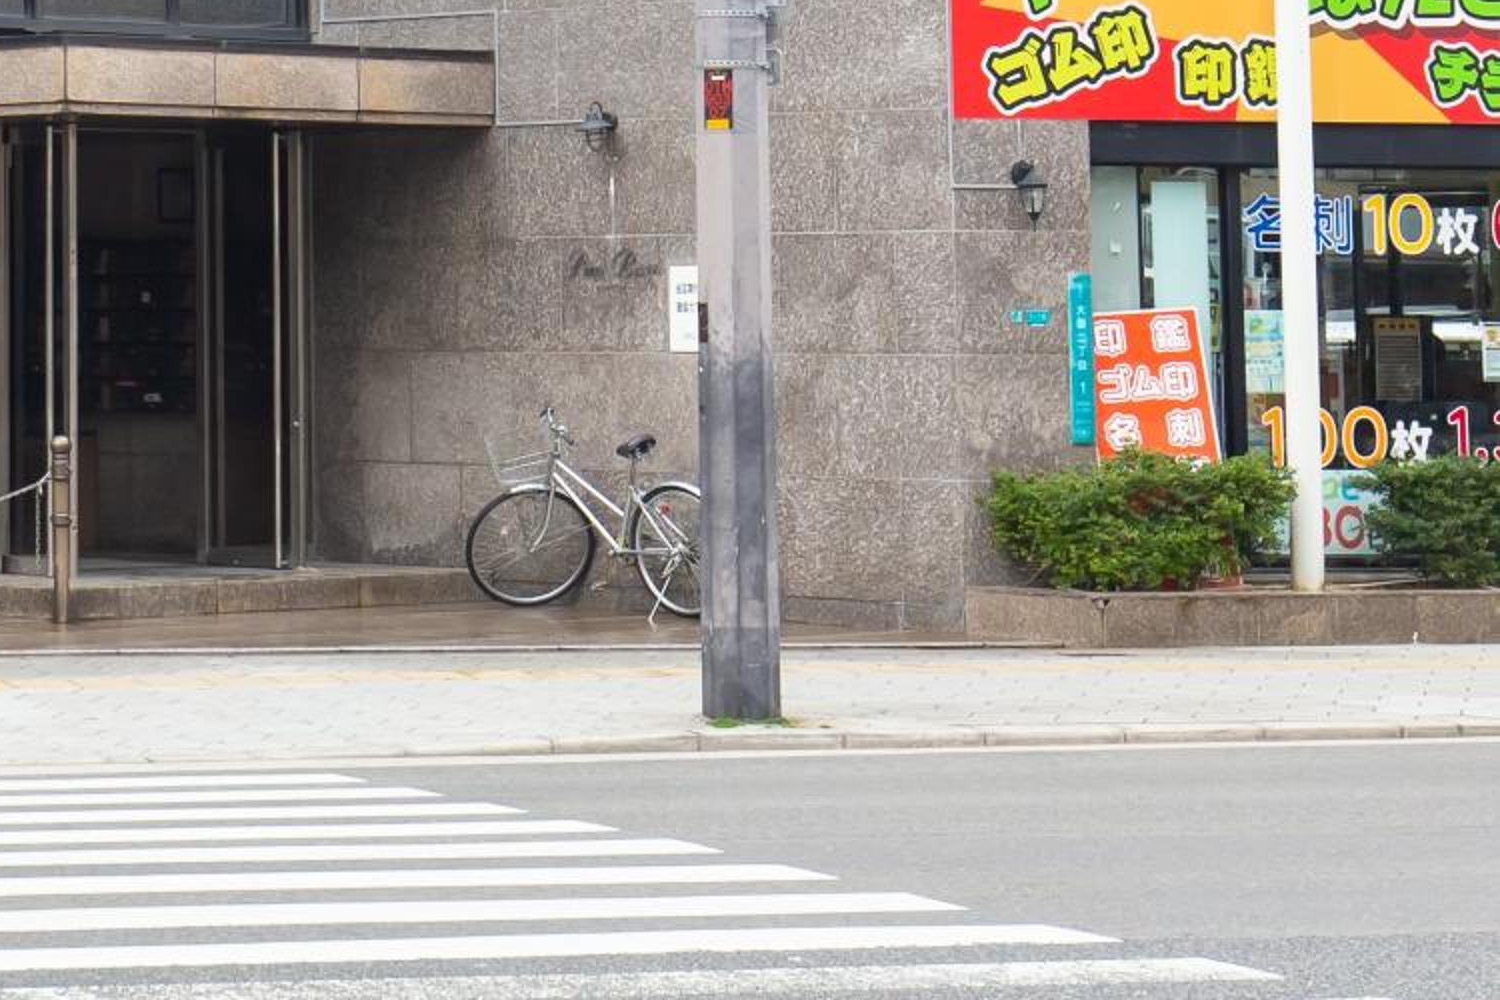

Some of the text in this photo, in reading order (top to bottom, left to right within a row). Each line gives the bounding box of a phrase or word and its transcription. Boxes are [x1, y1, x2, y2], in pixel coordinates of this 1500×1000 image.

[987, 7, 1153, 108] ゴム印
[1362, 193, 1480, 256] 10枚
[1098, 361, 1198, 404] ゴム印
